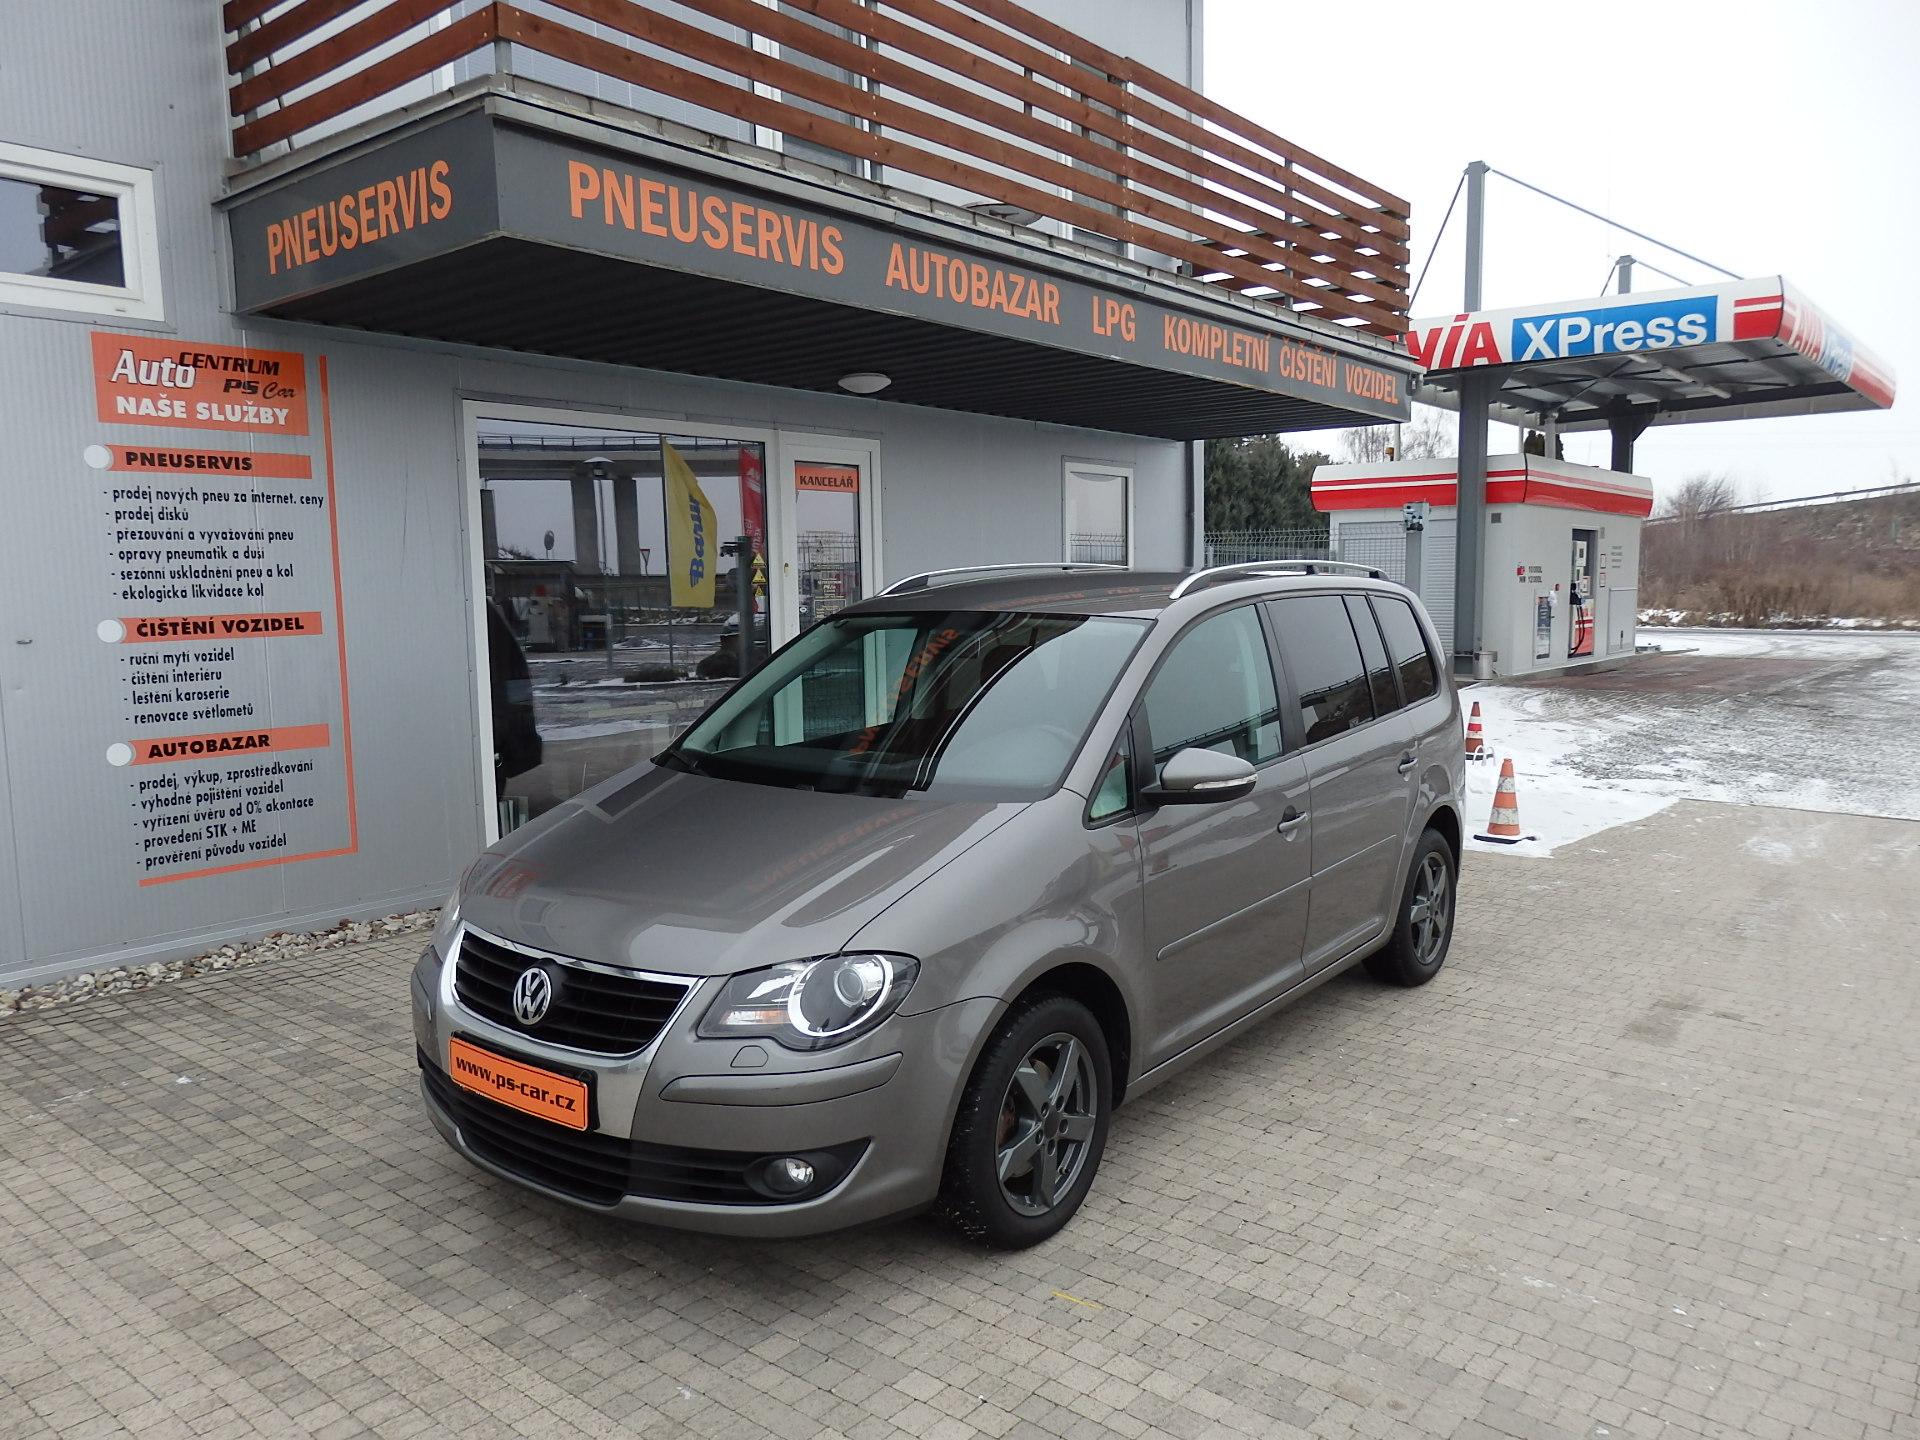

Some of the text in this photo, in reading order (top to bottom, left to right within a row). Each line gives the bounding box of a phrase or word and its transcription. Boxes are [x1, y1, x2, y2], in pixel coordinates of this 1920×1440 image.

[267, 159, 453, 275] PNEUSERVIS
[568, 160, 1399, 404] PNEUSERVIS AUTOBAZAR LPG KOMPLETNÍ ČIŠTĚNÍ VOZIDEL
[1520, 313, 1708, 362] XPress
[110, 349, 280, 389] Auto CENTRUM
[223, 378, 297, 399] PS Car
[116, 393, 289, 426] NAŠE SLUŽBY
[125, 451, 253, 471] PNEUSERVIS
[800, 475, 853, 488] KANCELÁŘ
[112, 486, 151, 504] prodej
[156, 487, 198, 504] nových
[202, 491, 230, 504] pneu
[234, 492, 247, 503] za
[300, 495, 324, 508] ceny
[115, 506, 154, 524] prodej
[116, 527, 294, 543] přezouvání a vyvažování pneu
[118, 550, 161, 564] opravy
[166, 546, 228, 561] pneumatik
[232, 550, 239, 560] a
[170, 565, 233, 579] uskladnění
[236, 567, 263, 581] pneu
[266, 568, 273, 578] a
[277, 563, 294, 578] kol
[122, 583, 264, 603] ekologická likvidace kol
[136, 617, 305, 637] ČIŠTĚNÍ VOZIDEL
[129, 647, 235, 667] ruční mytí vozidel
[131, 668, 222, 686] čištění interiéru
[132, 685, 230, 705] leštění karoserie
[134, 710, 188, 724] renovace
[148, 734, 271, 758] AUTOBAZAR
[227, 759, 313, 782] zprostředkování
[141, 779, 284, 812] výhodné pojištění vozidel
[143, 796, 314, 831] vyřízení úvěru od 0% akontace
[144, 829, 202, 851] provedení
[206, 824, 227, 839] STK
[242, 820, 256, 834] ME
[145, 833, 287, 870] prověření původu vozidel
[456, 1056, 576, 1112] www.ps-car.cz
